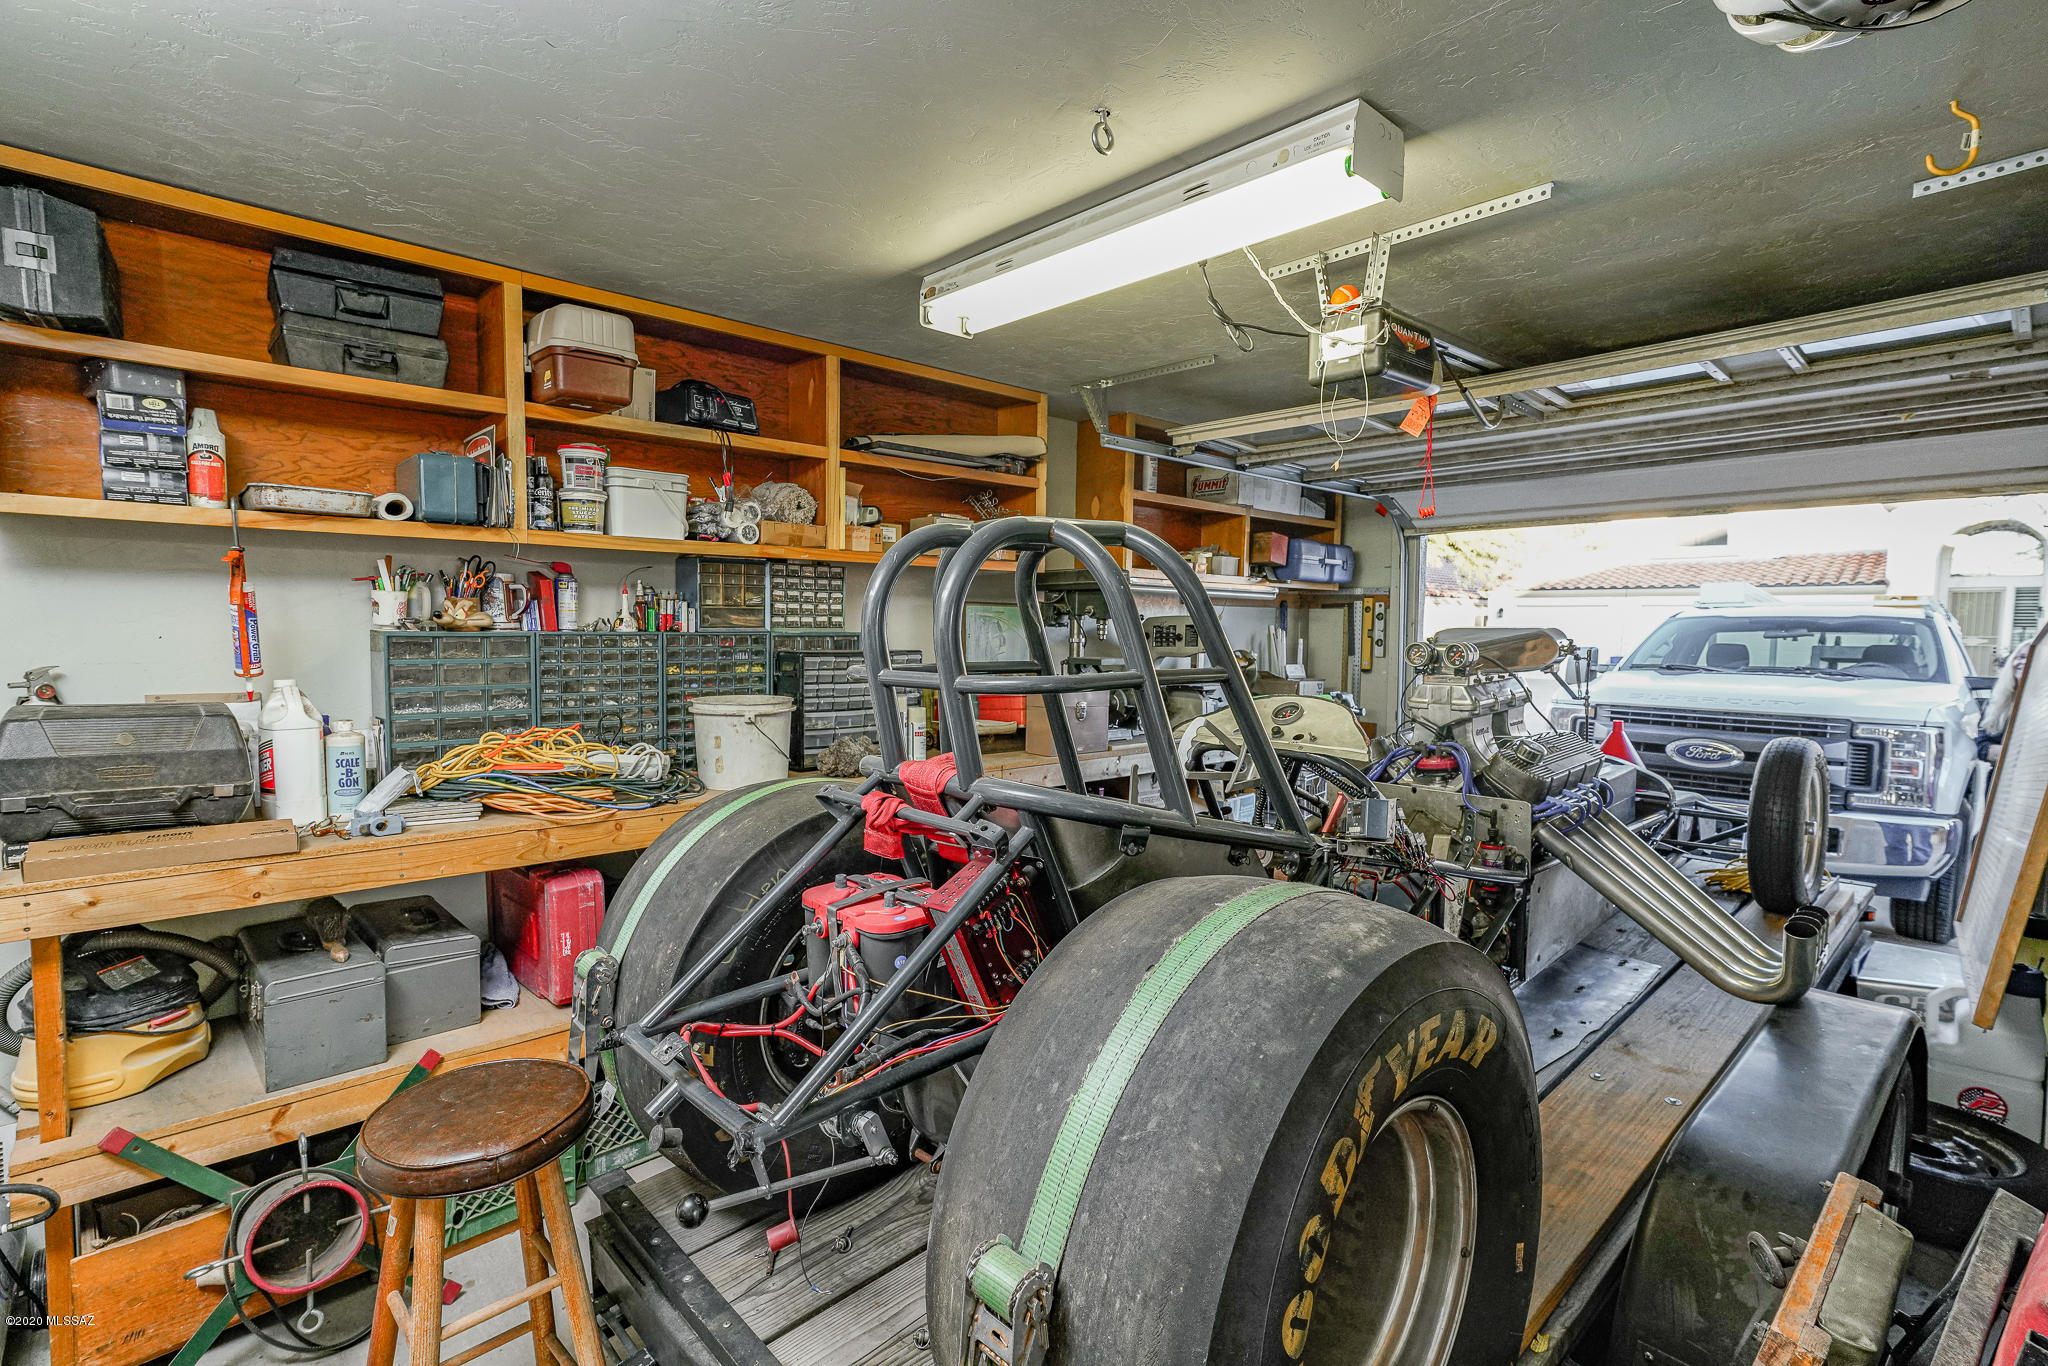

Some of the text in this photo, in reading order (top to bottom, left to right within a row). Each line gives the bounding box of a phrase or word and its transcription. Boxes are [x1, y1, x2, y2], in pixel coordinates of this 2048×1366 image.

[1391, 322, 1431, 346] QUANTUM
[192, 442, 220, 453] AMDRO
[1192, 473, 1229, 498] SUMMIT
[249, 619, 258, 642] Power
[251, 643, 260, 662] Grab
[1685, 746, 1721, 761] Ford
[335, 758, 360, 769] SCALE
[340, 768, 358, 778] -B-
[338, 777, 359, 788] GON
[1281, 1009, 1498, 1366] OODYEAR
